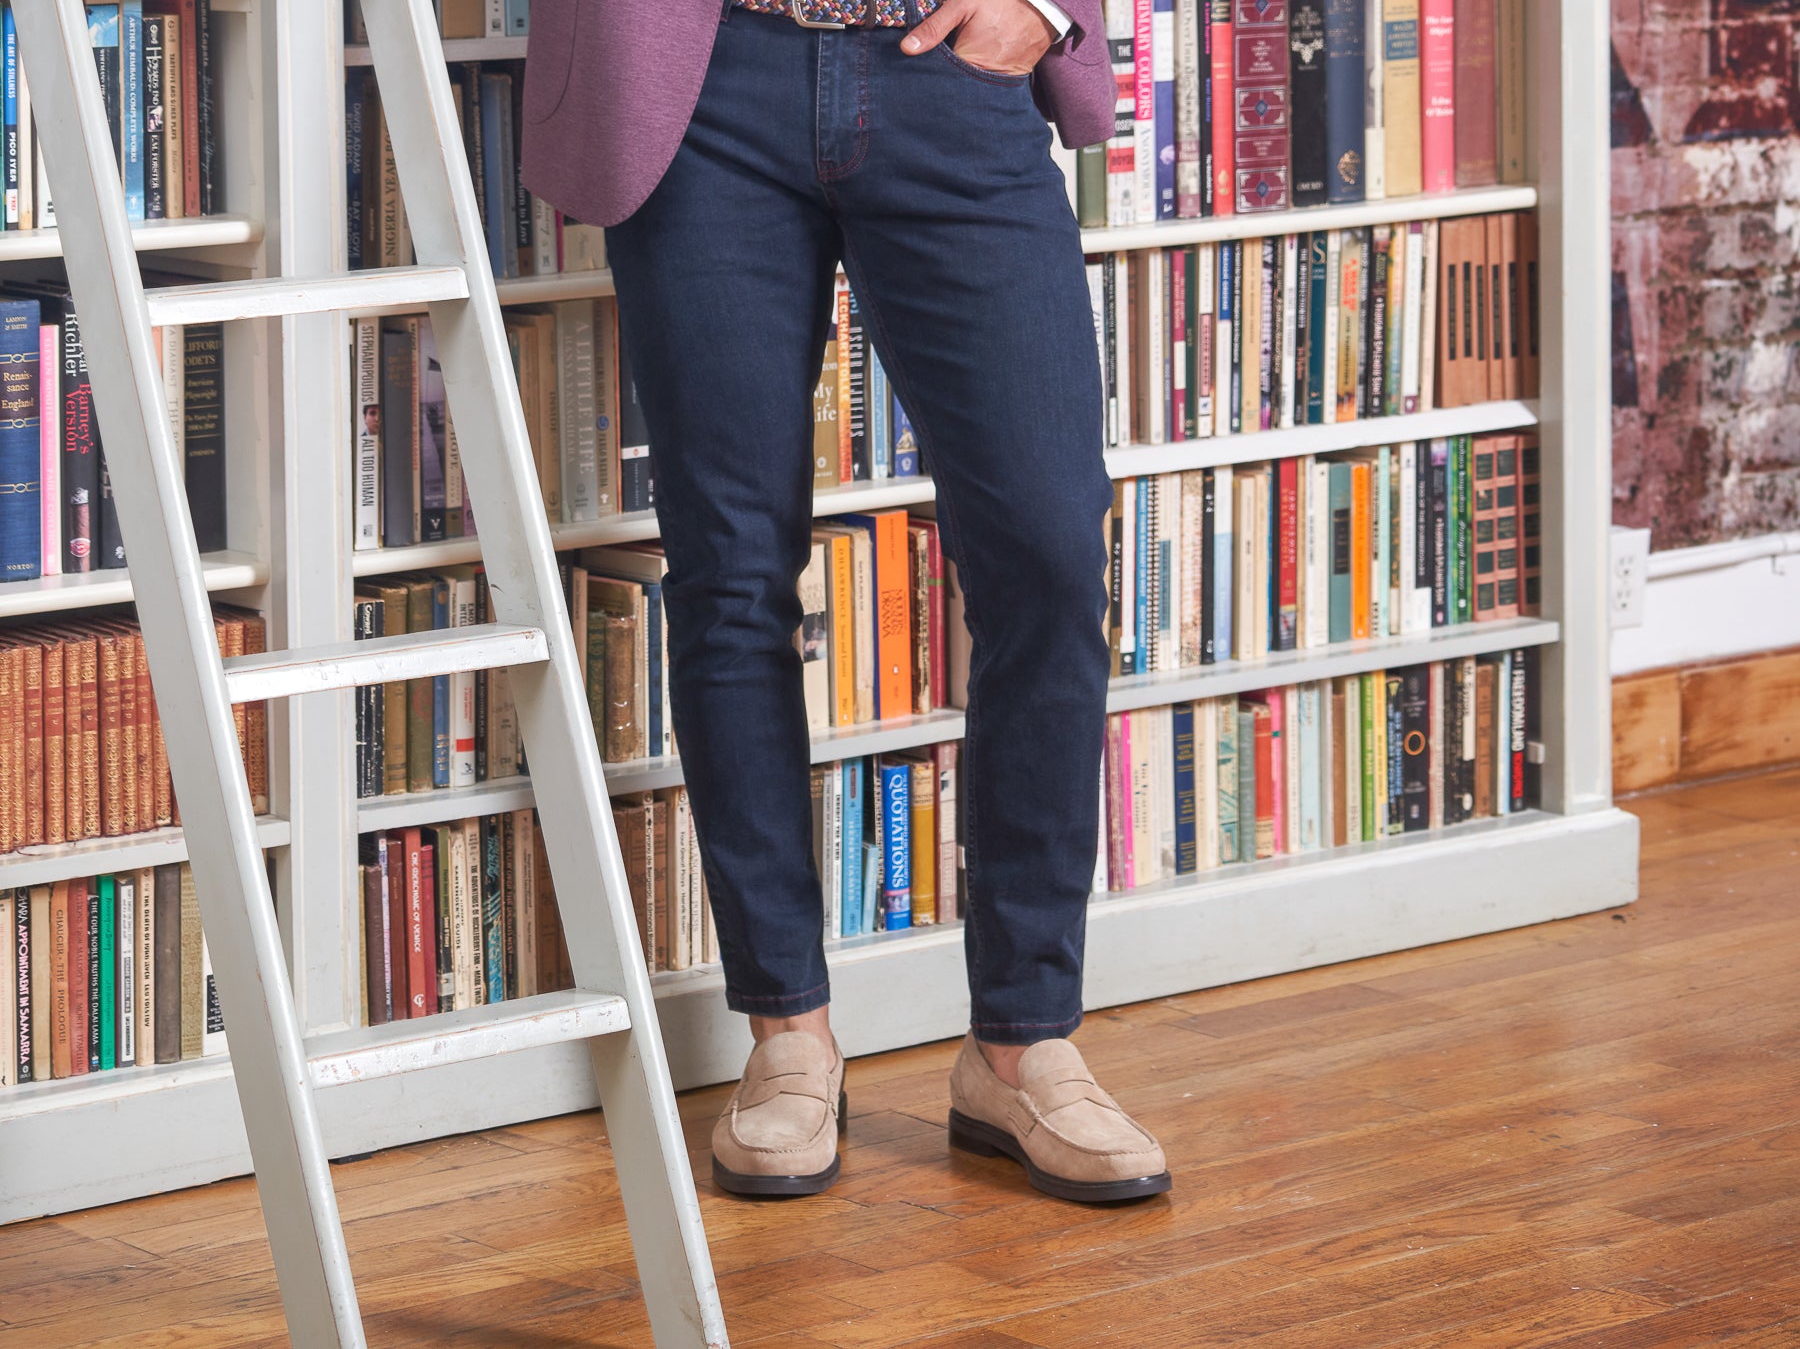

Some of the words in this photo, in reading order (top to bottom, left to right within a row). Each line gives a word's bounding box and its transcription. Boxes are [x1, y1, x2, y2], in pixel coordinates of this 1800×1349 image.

[1136, 55, 1153, 119] COLORS
[9, 132, 17, 155] PICO
[385, 158, 395, 193] YEAR
[385, 199, 395, 256] NIGERIA
[65, 313, 78, 377] Richler
[838, 295, 849, 358] ECKHART
[850, 326, 863, 367] OSCAR
[3, 371, 32, 383] Renais-
[6, 383, 30, 392] sance
[361, 325, 375, 403] STEPHANOPOULOS
[577, 341, 591, 419] LITTLE
[840, 362, 850, 403] TOLLE
[1, 397, 34, 410] England
[66, 389, 78, 452] Version
[79, 383, 96, 455] Barney's
[362, 438, 375, 454] ALL
[362, 456, 375, 472] TOO
[578, 426, 594, 474] LIFE
[362, 474, 375, 508] HUMAN
[889, 774, 904, 888] QUOTATIONS
[56, 909, 64, 956] CHAUCER
[17, 924, 30, 993] APPOINTMENT
[20, 993, 30, 1006] IN
[58, 989, 66, 1045] PROLOGUE
[20, 1007, 31, 1064] SAMARRA
